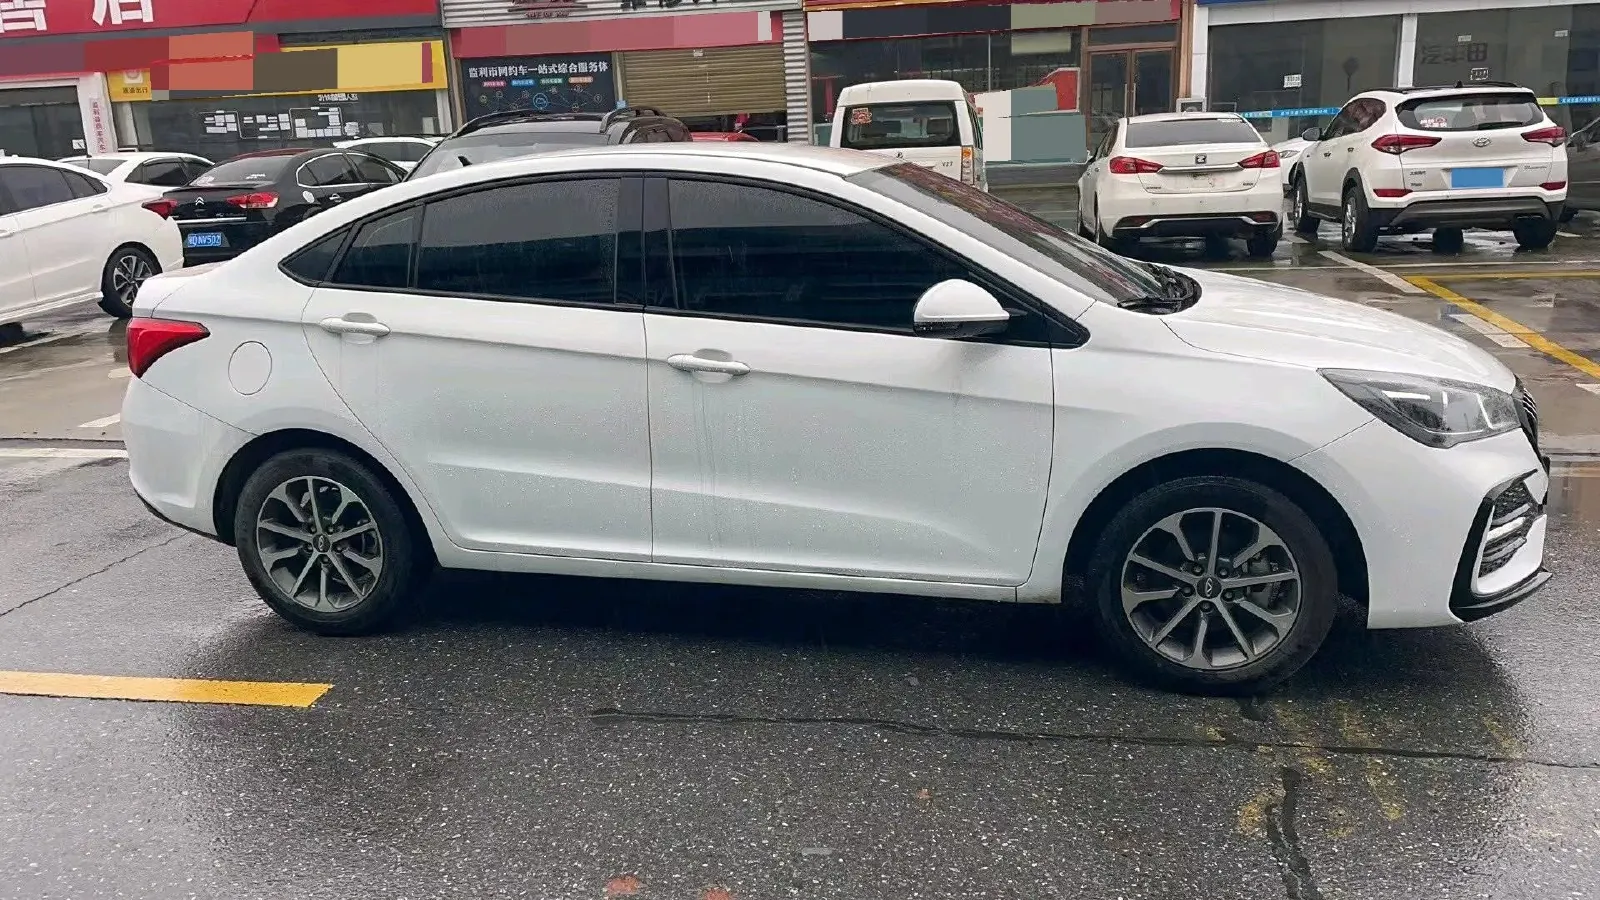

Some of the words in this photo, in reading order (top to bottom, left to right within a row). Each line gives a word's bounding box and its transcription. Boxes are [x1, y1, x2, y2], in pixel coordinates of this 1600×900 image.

[468, 61, 609, 78] 监利市网约车一站式综合服务体
